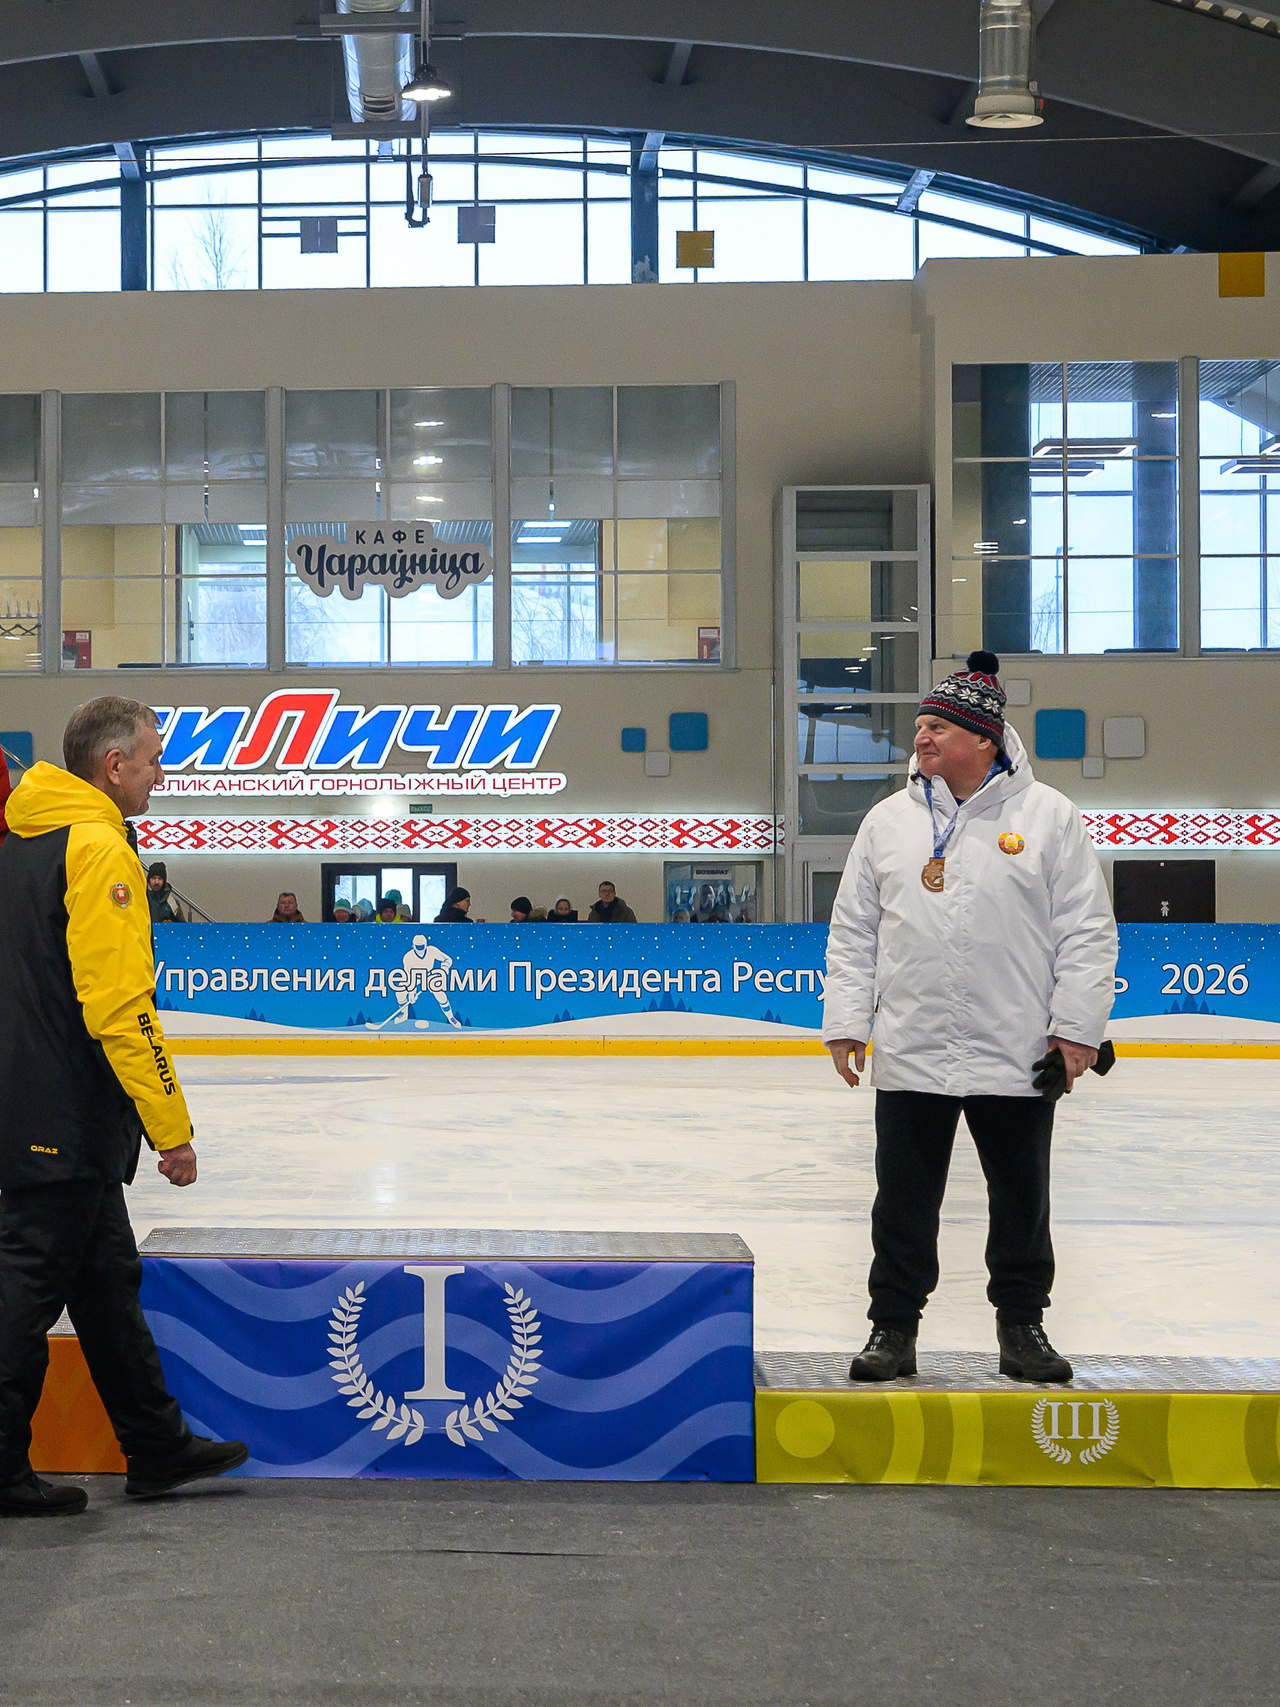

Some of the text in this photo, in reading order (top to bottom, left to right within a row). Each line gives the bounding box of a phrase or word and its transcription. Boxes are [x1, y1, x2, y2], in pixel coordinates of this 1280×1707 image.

[355, 529, 425, 545] КАФЕ
[296, 544, 484, 592] Чараўніца
[310, 775, 487, 790] ГОРНОЛЫЖНЫЙ
[492, 777, 562, 793] ЦЕНТР
[364, 967, 497, 998] делами
[508, 961, 721, 999] Президента
[1160, 963, 1249, 995] 2026
[137, 1012, 176, 1096] BELARUS
[30, 1144, 59, 1155] ORAZ
[403, 1265, 466, 1400] I
[1046, 1401, 1105, 1439] III
